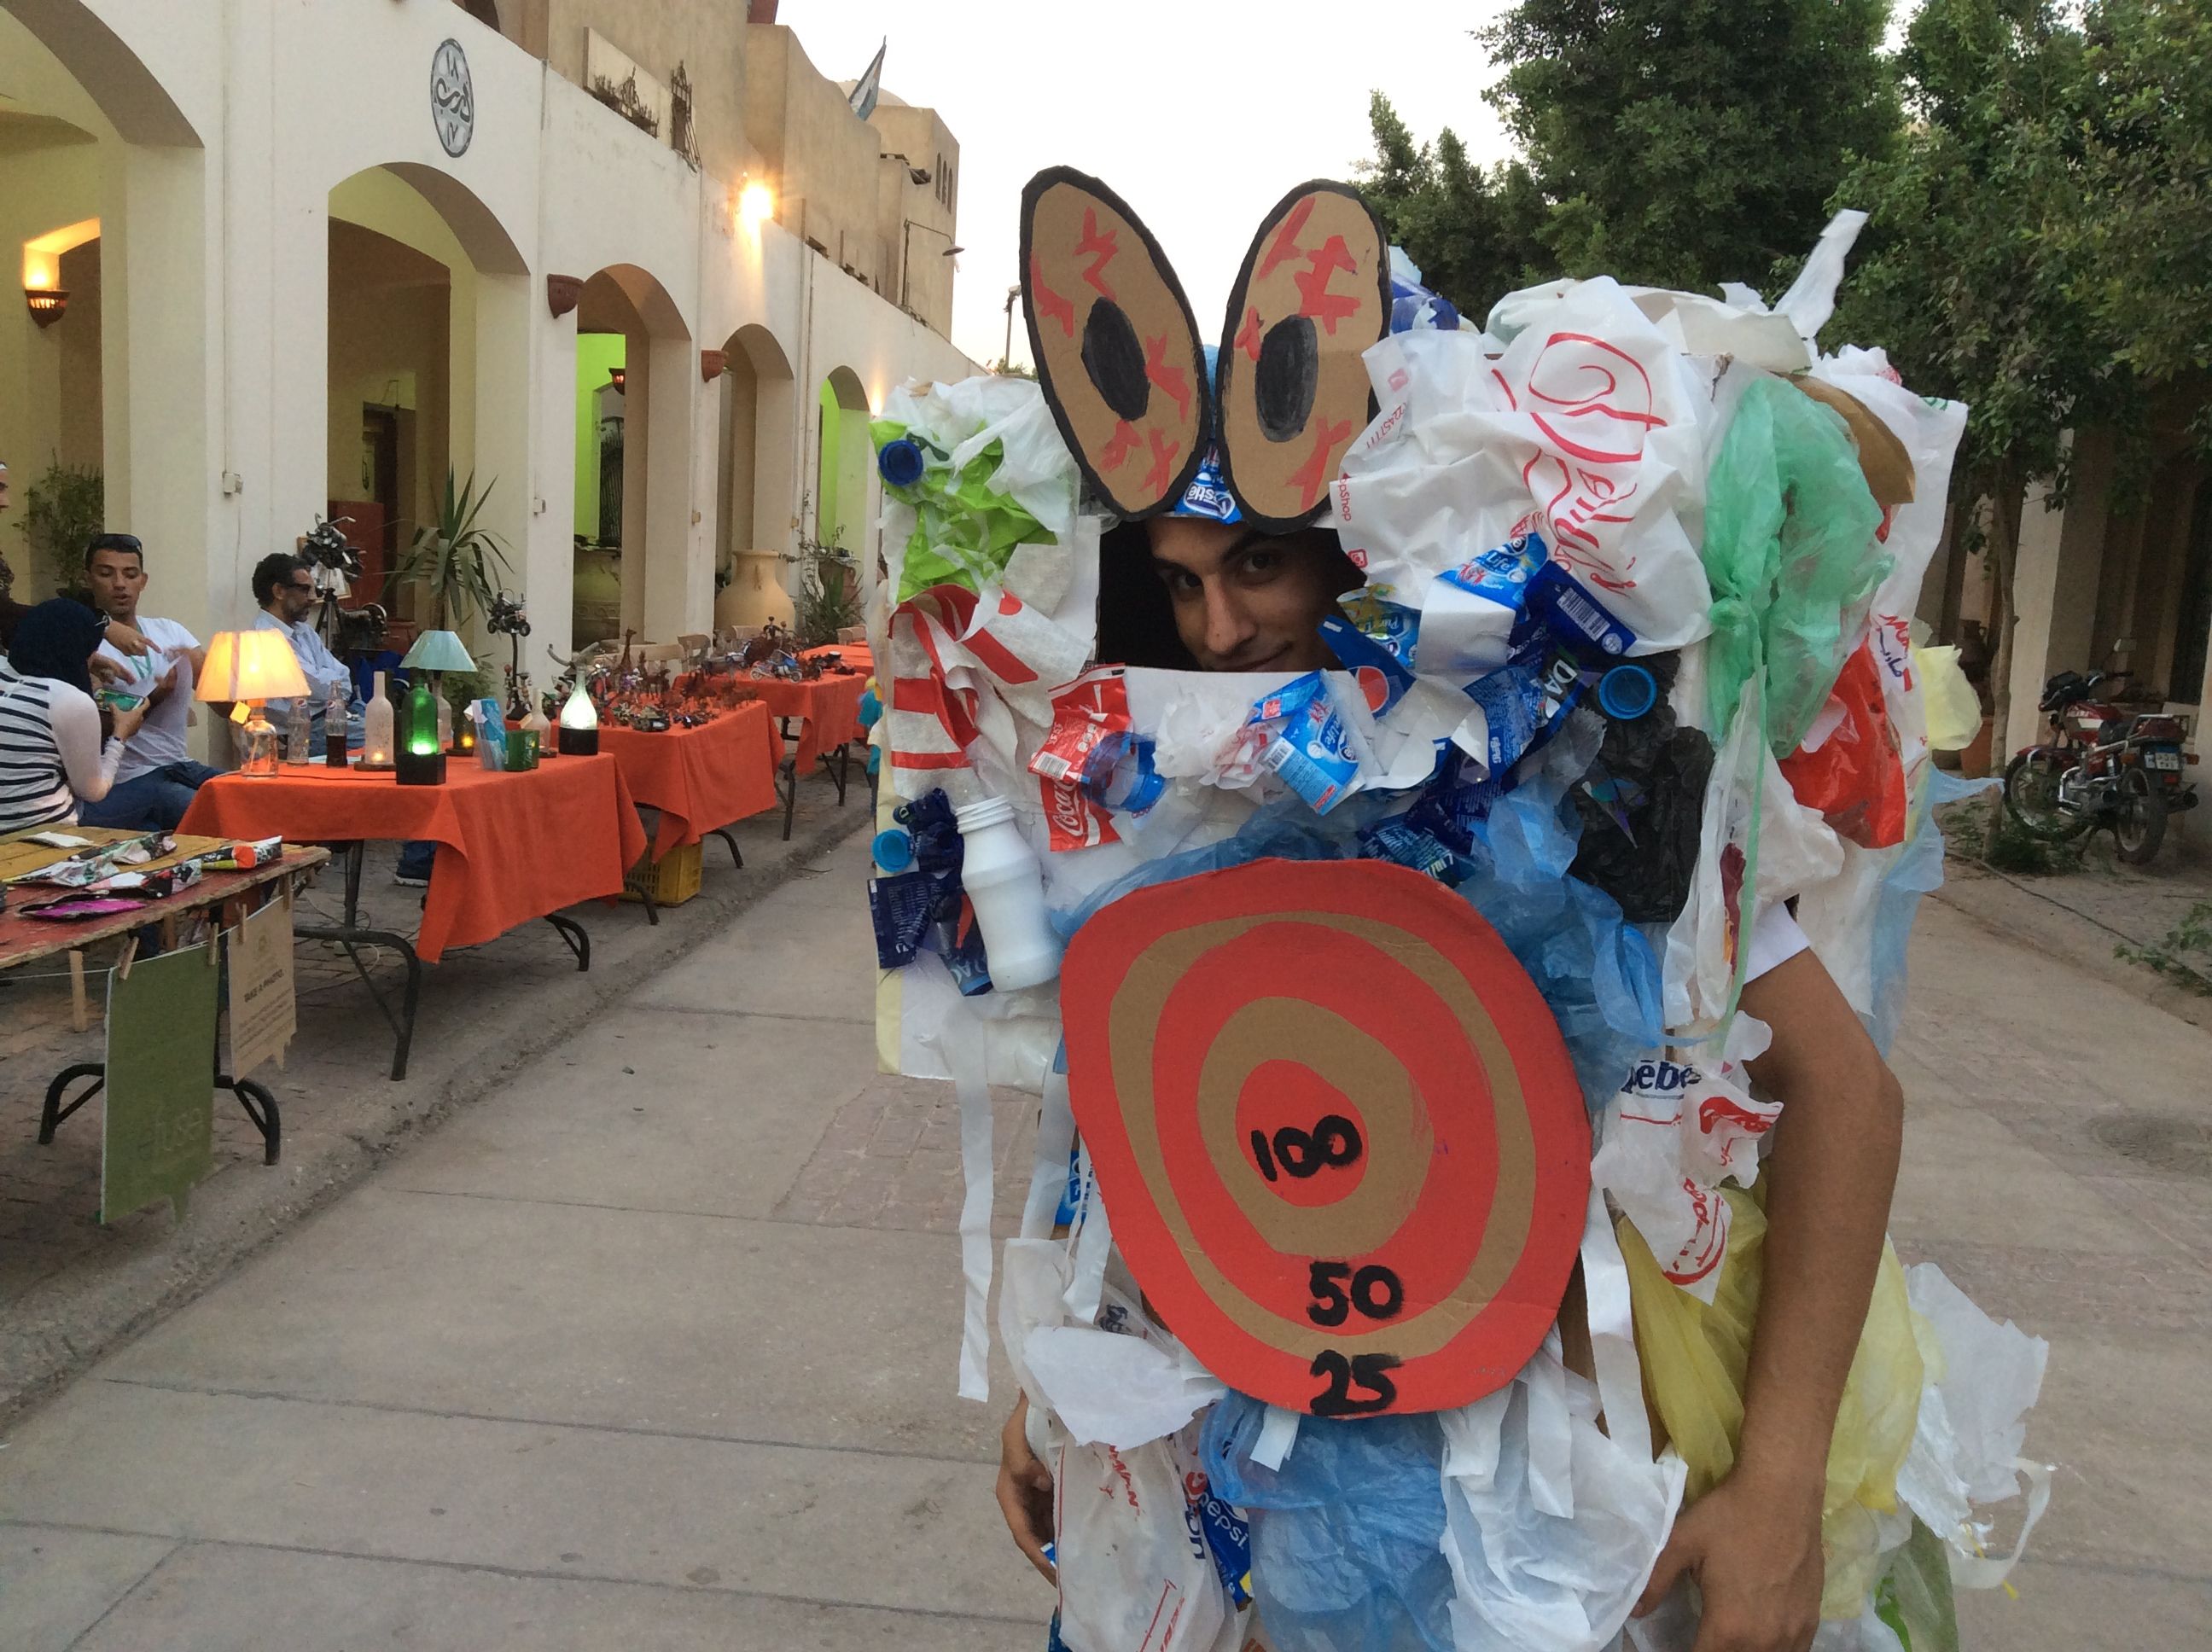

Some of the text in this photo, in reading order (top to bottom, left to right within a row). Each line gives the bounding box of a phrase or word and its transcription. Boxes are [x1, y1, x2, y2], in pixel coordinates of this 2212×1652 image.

[1250, 1114, 1363, 1183] 100
[1306, 1259, 1405, 1327] 50
[1309, 1348, 1406, 1417] 25
